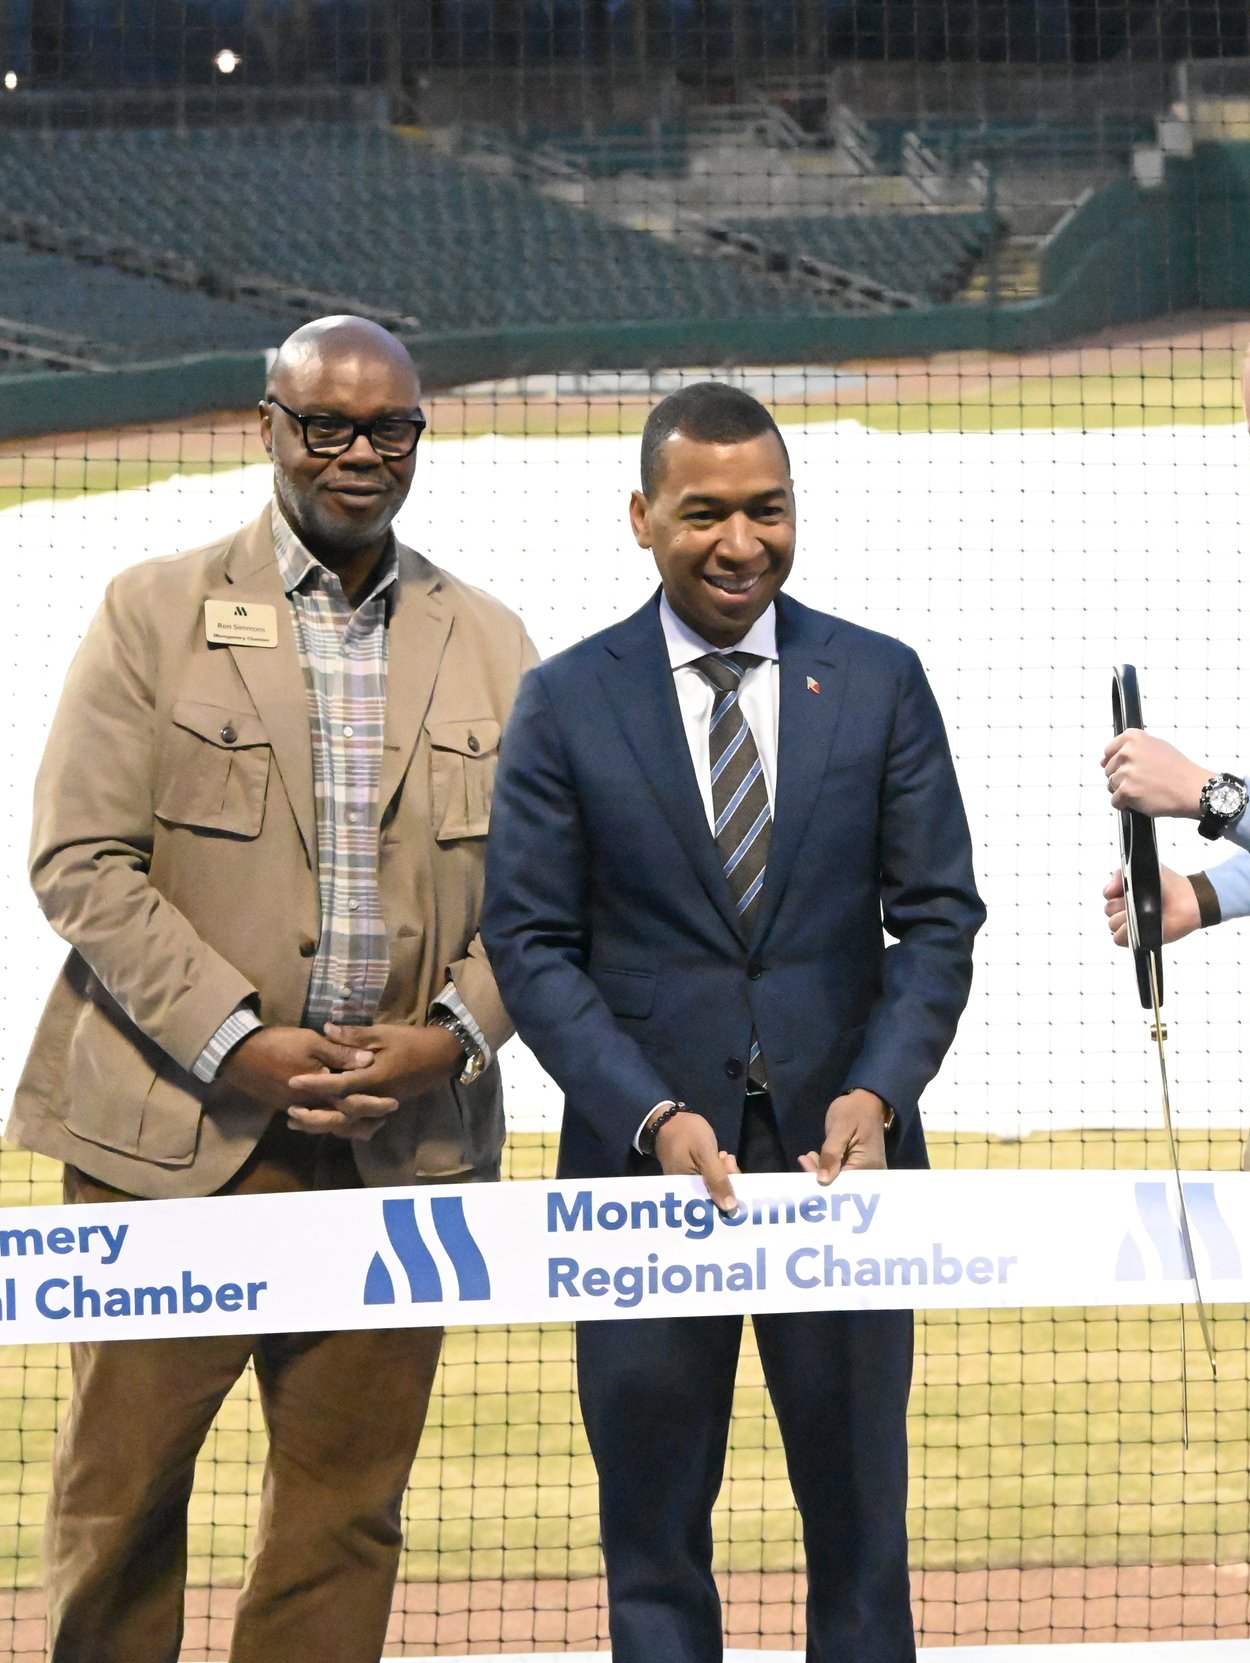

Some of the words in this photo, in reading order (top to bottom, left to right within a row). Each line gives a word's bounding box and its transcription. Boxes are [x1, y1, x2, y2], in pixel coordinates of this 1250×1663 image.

[547, 1190, 880, 1239] Montgomery
[35, 1271, 267, 1320] Chamber
[548, 1248, 767, 1308] Regional
[785, 1243, 1018, 1290] Chamber
